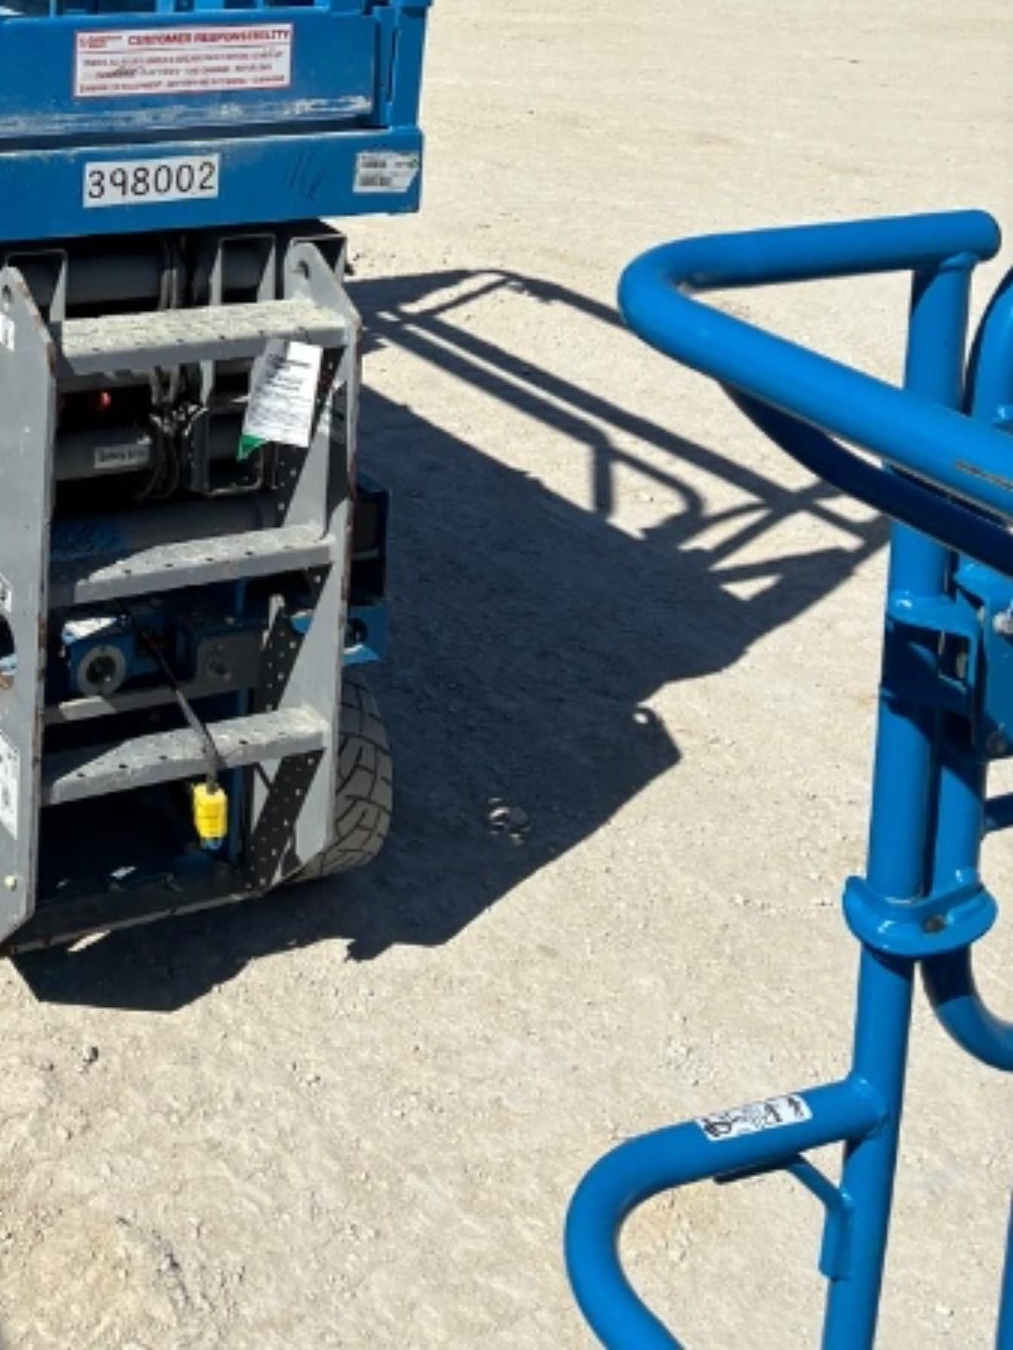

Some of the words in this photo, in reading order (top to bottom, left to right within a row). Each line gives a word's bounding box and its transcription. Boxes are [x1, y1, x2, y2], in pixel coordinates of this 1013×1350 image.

[127, 32, 192, 47] CUSTOMER
[193, 29, 290, 43] RESPONSIBILITY
[87, 160, 216, 199] 398002
